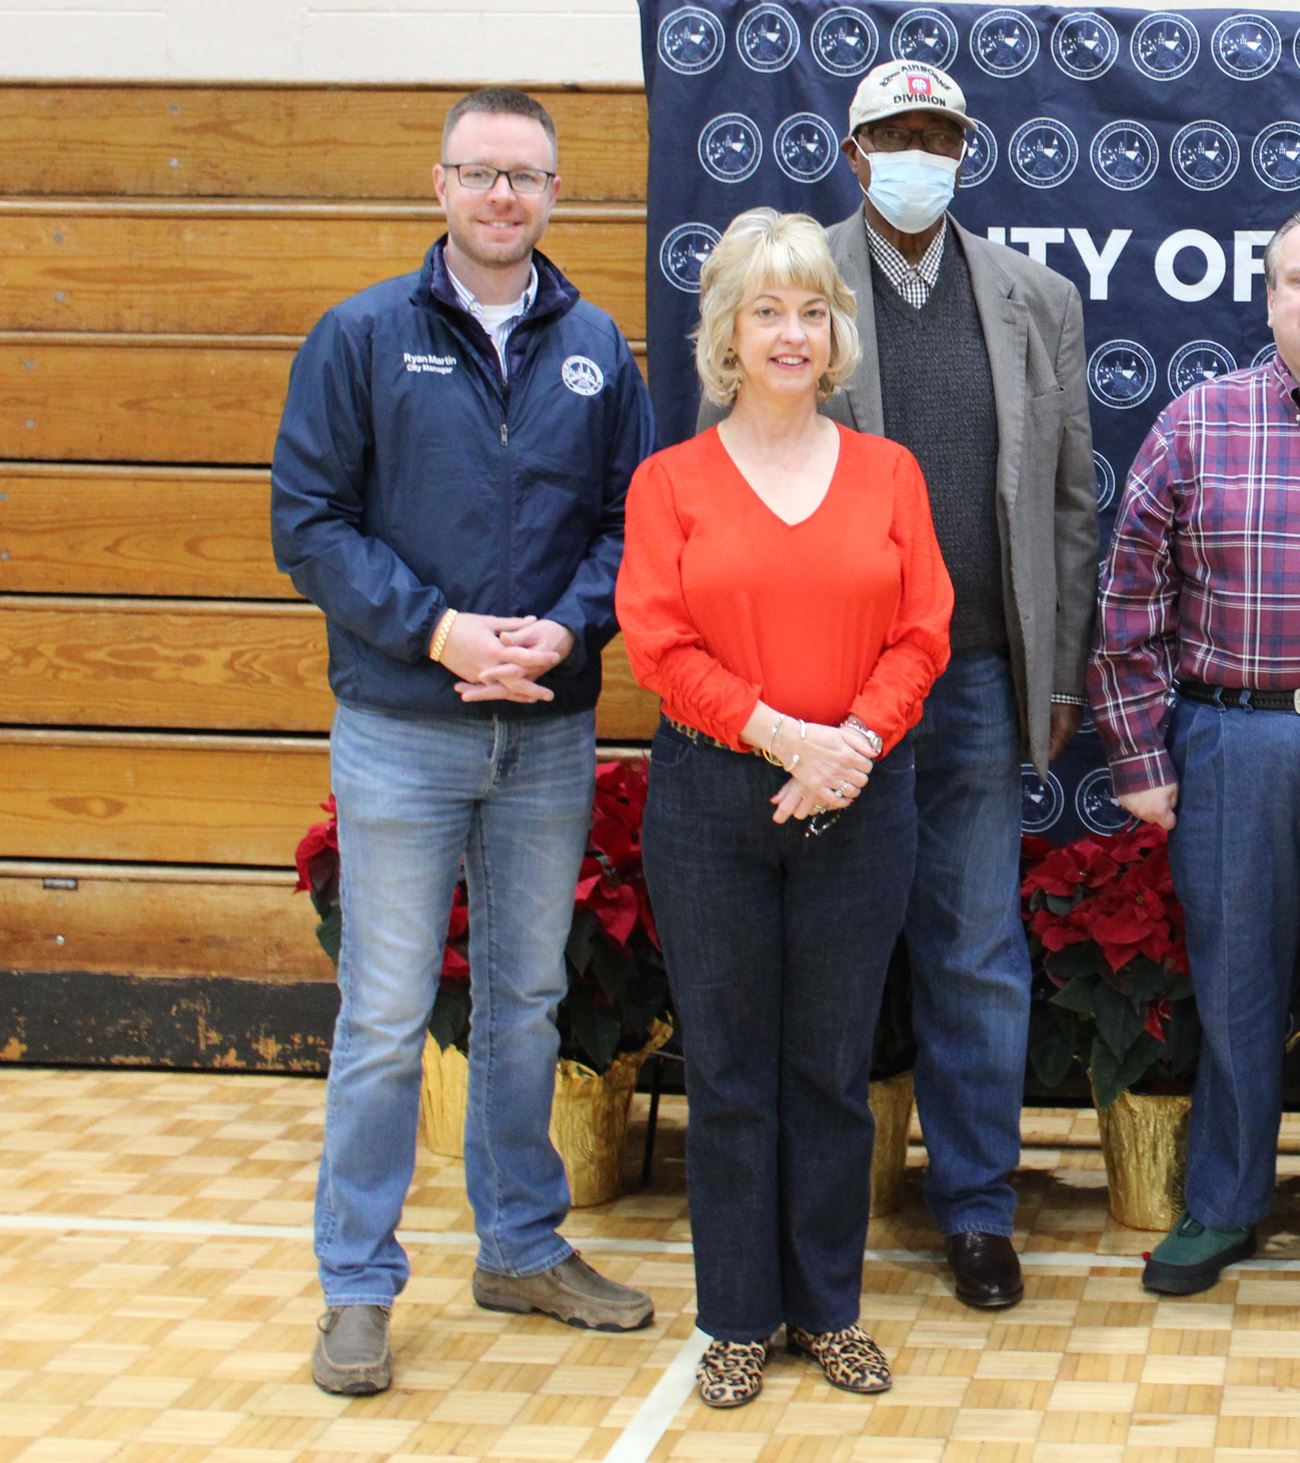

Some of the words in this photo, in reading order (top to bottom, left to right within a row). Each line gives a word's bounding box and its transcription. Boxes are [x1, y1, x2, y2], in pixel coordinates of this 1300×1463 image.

[893, 94, 946, 107] DIVISION
[988, 227, 1133, 300] TY
[403, 352, 428, 364] Ryan
[428, 354, 457, 365] Martin
[406, 363, 421, 373] City
[422, 364, 453, 375] Manager
